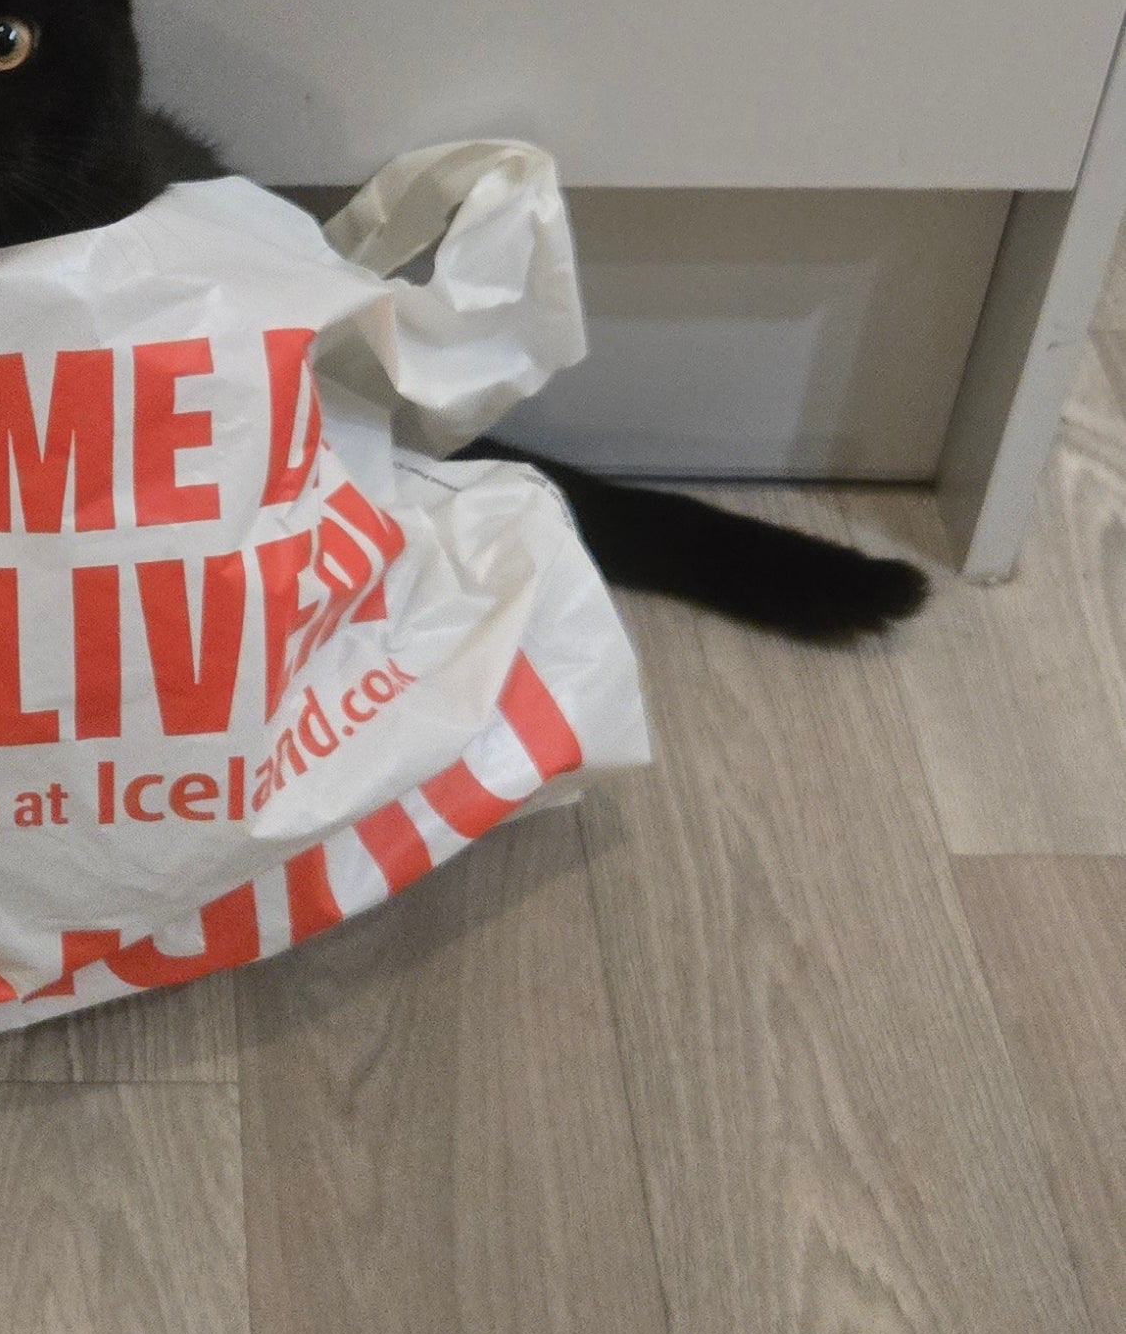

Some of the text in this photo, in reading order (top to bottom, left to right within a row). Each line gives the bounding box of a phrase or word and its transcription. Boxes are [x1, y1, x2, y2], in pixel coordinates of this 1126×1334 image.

[261, 327, 326, 509] D
[15, 783, 68, 827] at
[97, 658, 419, 824] Iceland.co
